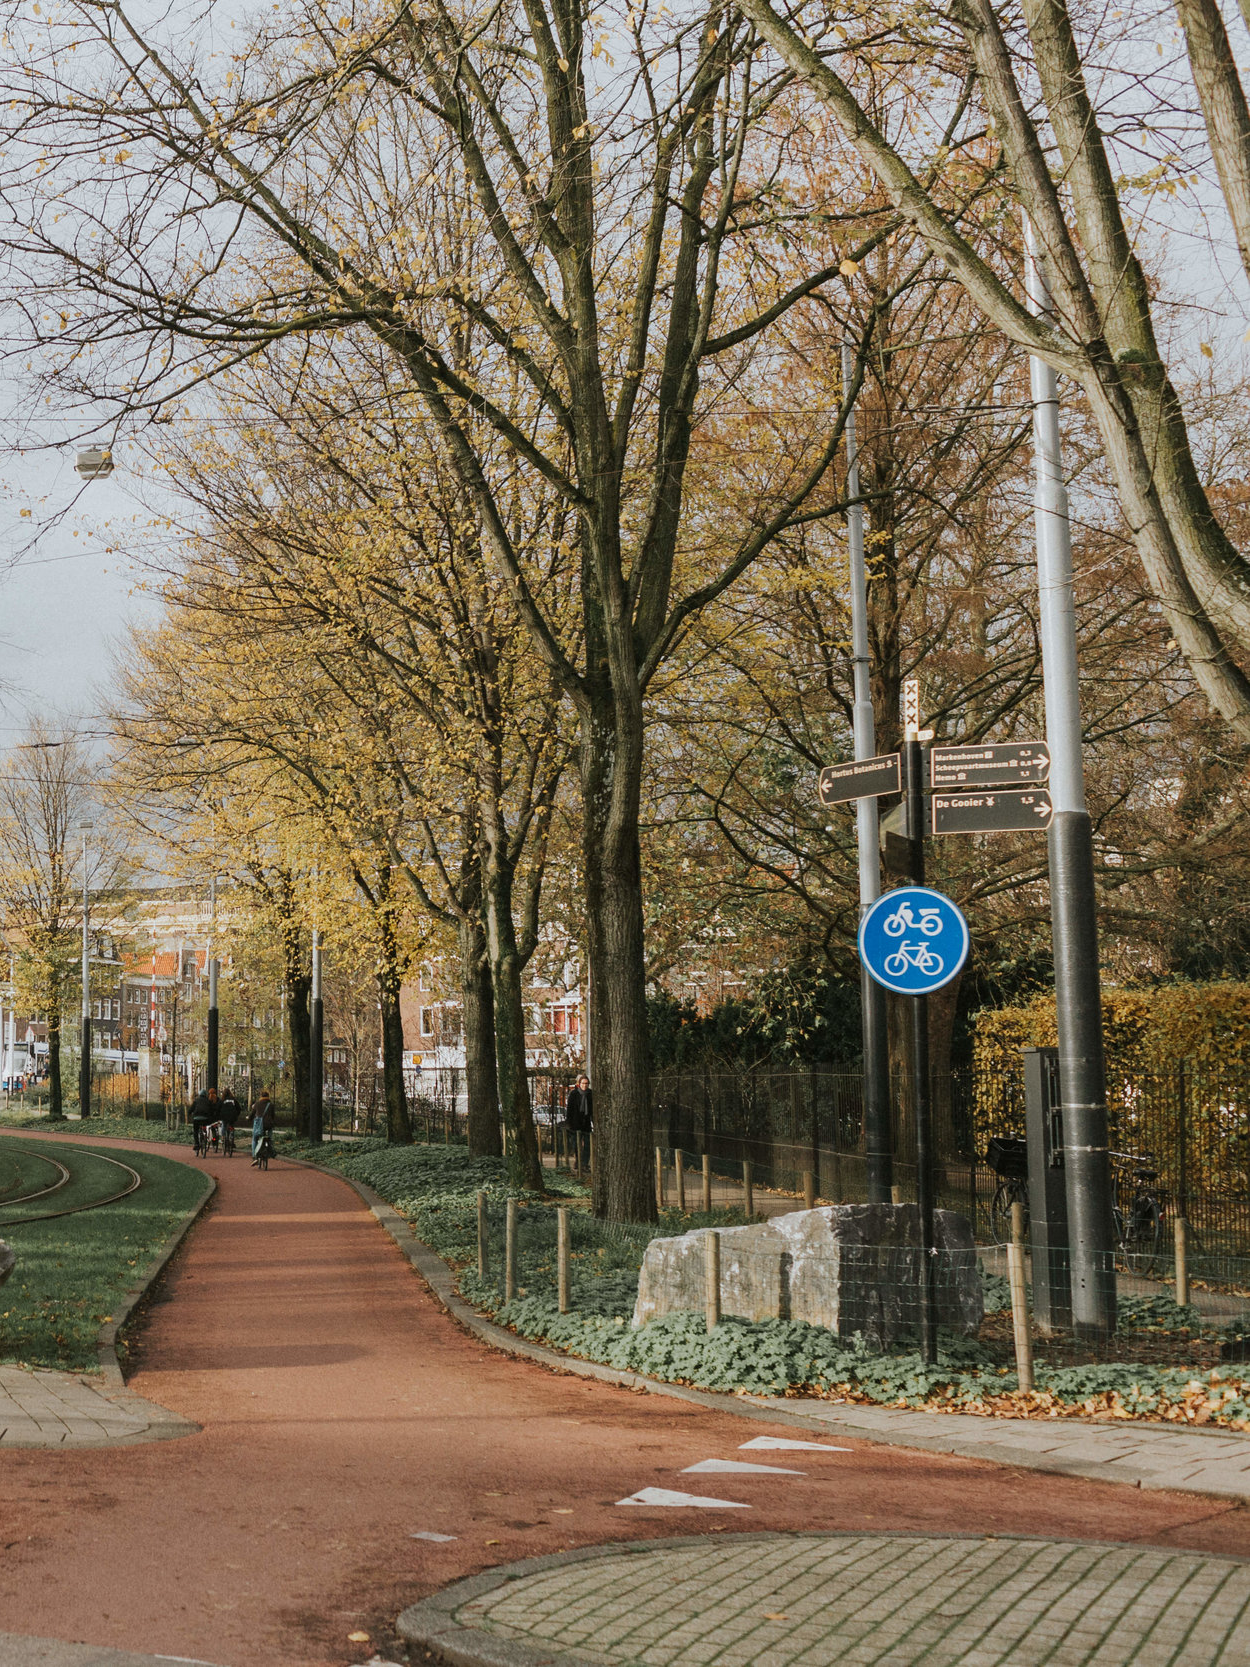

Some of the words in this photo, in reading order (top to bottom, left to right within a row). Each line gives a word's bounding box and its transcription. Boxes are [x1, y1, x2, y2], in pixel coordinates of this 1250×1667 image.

[935, 752, 984, 762] Markenhoven
[831, 769, 854, 779] Hortus
[854, 763, 886, 775] Botanicus
[935, 762, 1008, 772] Scheepvaartmuseum
[936, 800, 949, 809] De
[951, 798, 984, 808] Gooier
